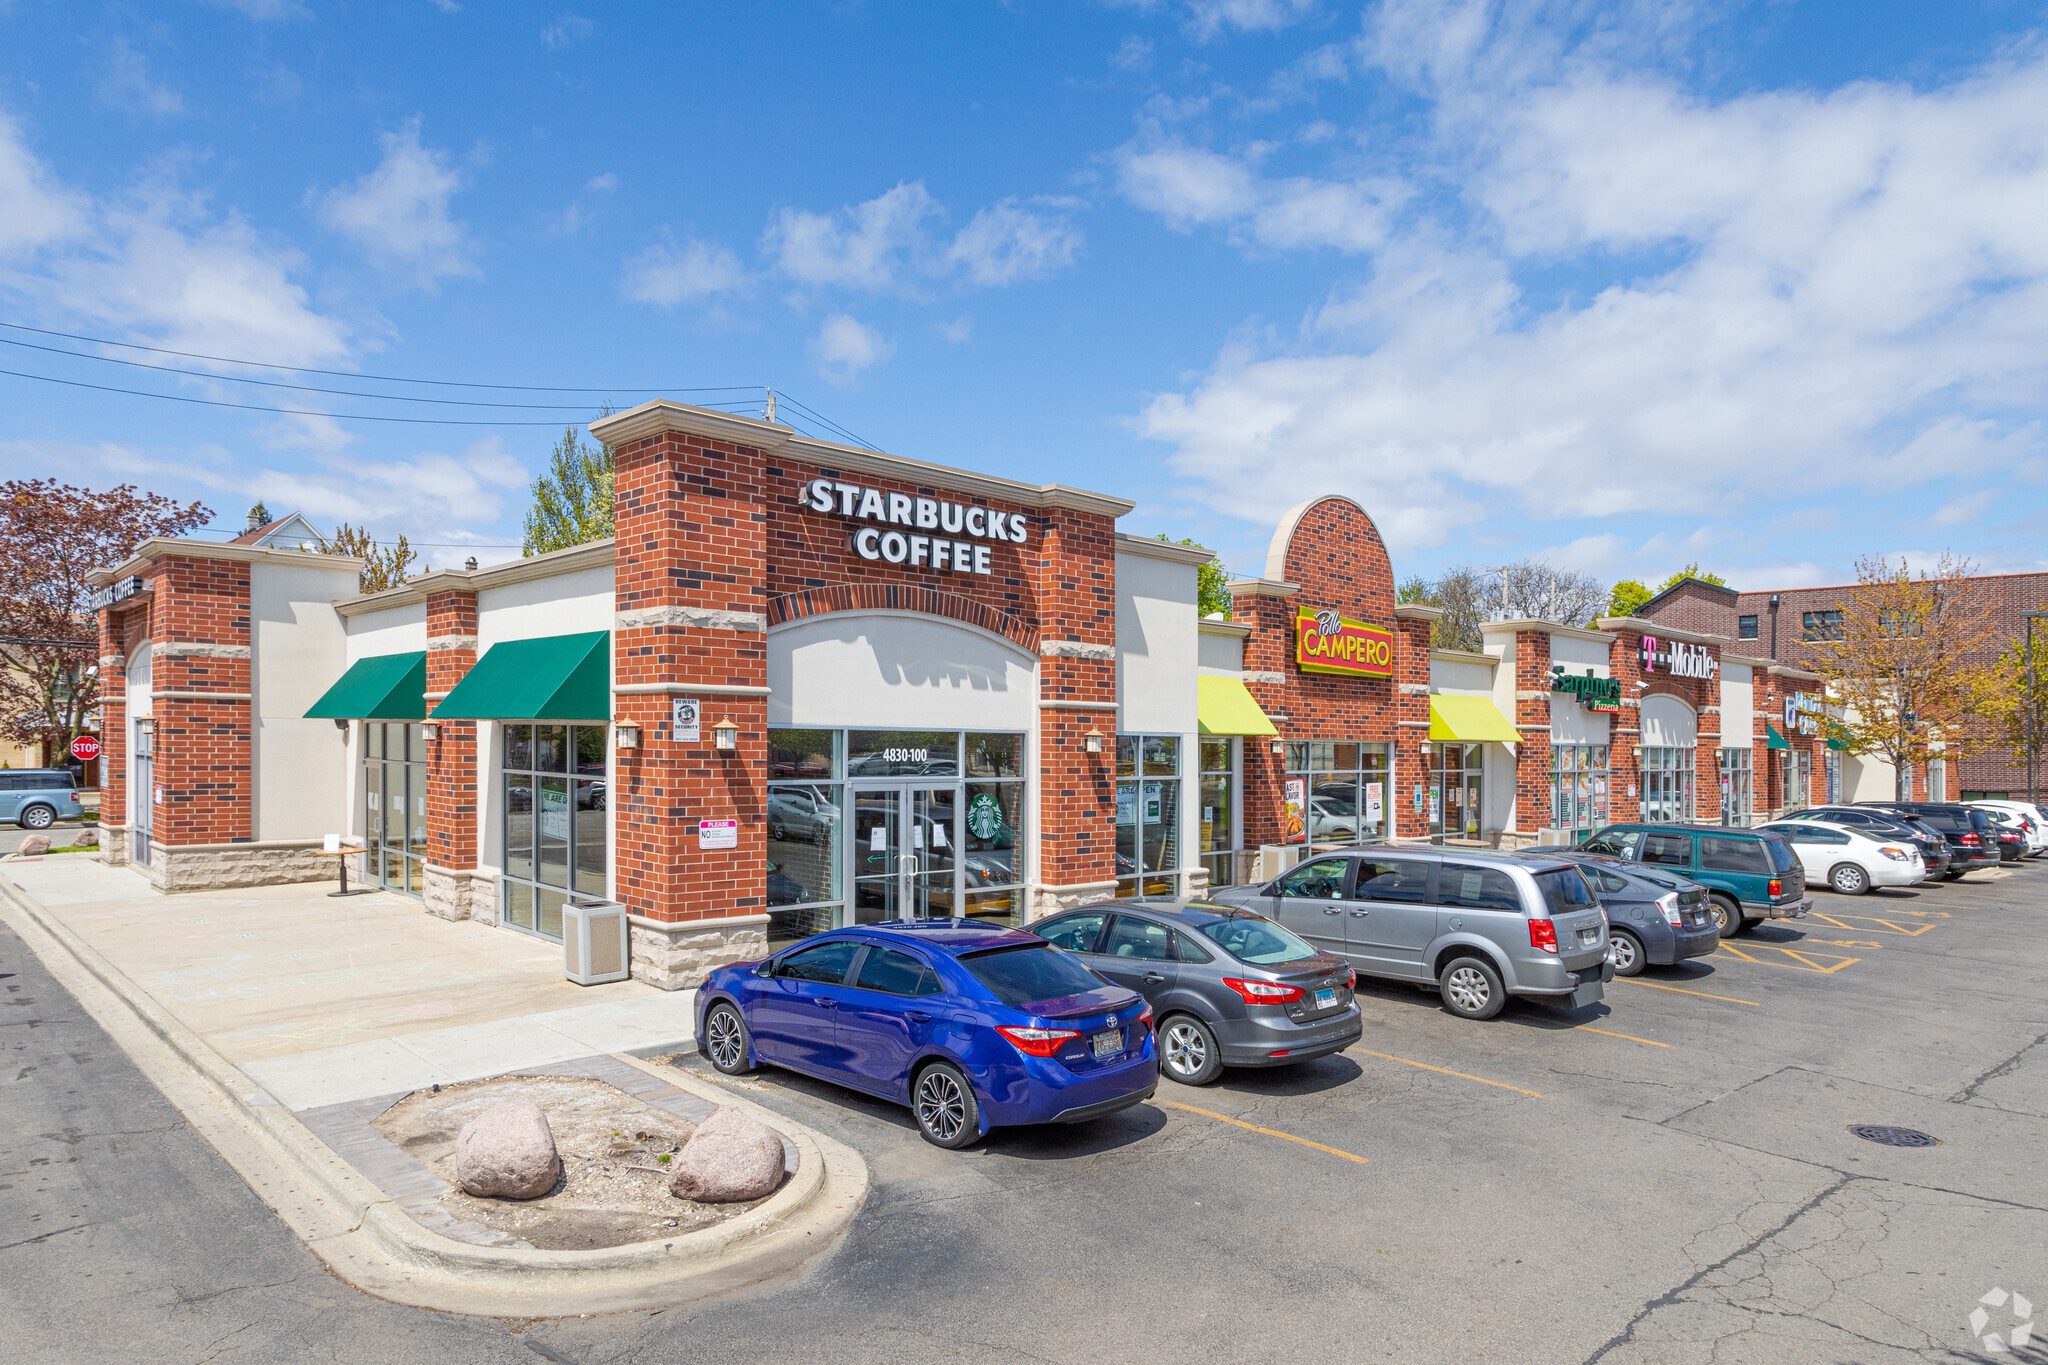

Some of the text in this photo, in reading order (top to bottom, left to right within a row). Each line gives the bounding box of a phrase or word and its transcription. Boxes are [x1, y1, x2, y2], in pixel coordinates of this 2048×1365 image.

[806, 478, 1028, 543] STARBUCKS
[852, 527, 992, 575] COFFEE
[114, 575, 135, 602] COFFEE
[1314, 610, 1343, 636] Pollo
[1303, 628, 1390, 667] CAMPERO
[1594, 700, 1619, 712] Pizzeria
[73, 743, 99, 753] STOP
[883, 748, 928, 762] 4830-100
[1286, 791, 1300, 801] LAVOR
[701, 830, 711, 839] NO
